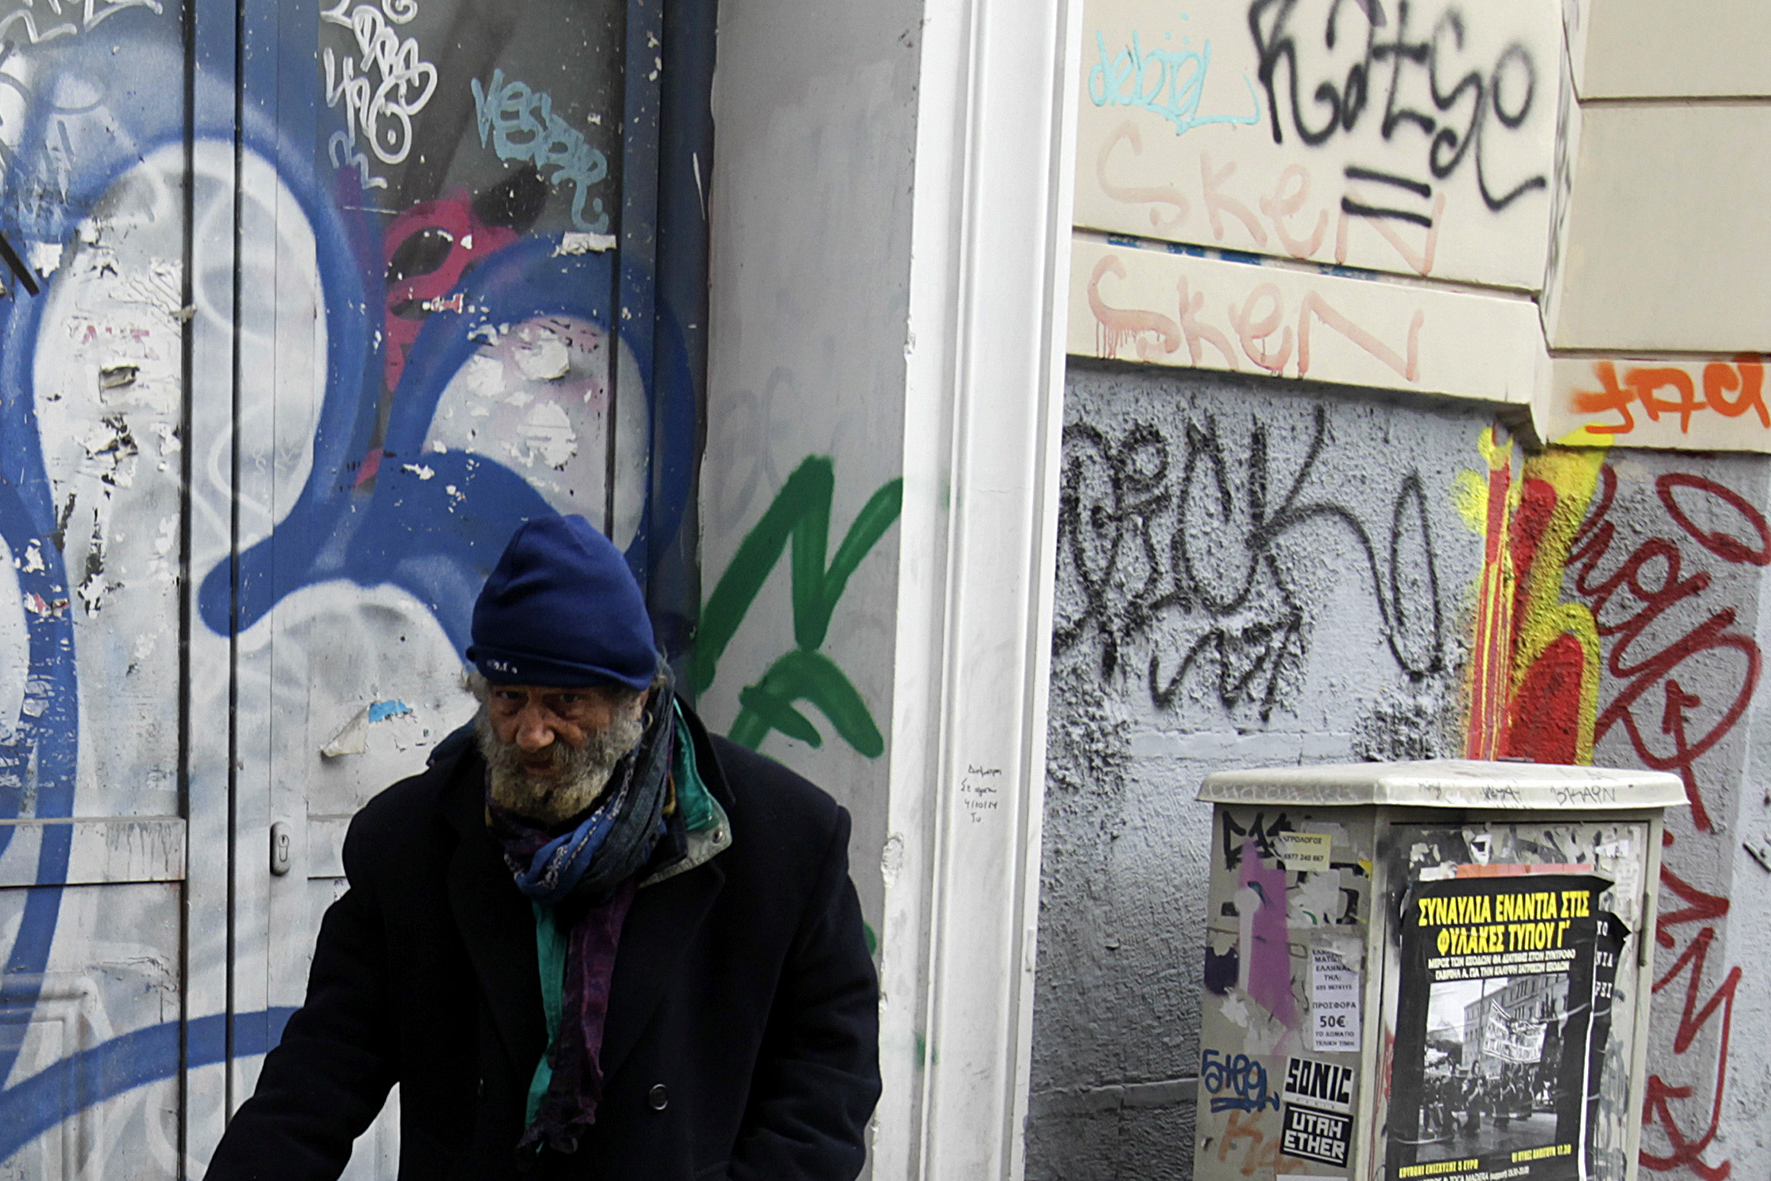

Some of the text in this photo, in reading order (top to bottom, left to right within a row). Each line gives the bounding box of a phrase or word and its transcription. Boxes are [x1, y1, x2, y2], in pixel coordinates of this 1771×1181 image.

[1418, 890, 1590, 926] ΣΥΝΑΥΛΙΑ ΕΝΑΝΤΙΑ ΣΤΙΣ
[1436, 925, 1504, 956] ΦΥΛΑΚΕΣ
[1508, 921, 1556, 951] ΤΥΠΟΥ
[1312, 1002, 1356, 1010] ΠΡΟΣΦΟΡΑ
[1320, 1015, 1346, 1028] 50€
[1285, 1057, 1353, 1104] SONIC
[1292, 1112, 1343, 1138] UTAH
[1283, 1130, 1345, 1160] ETHER
